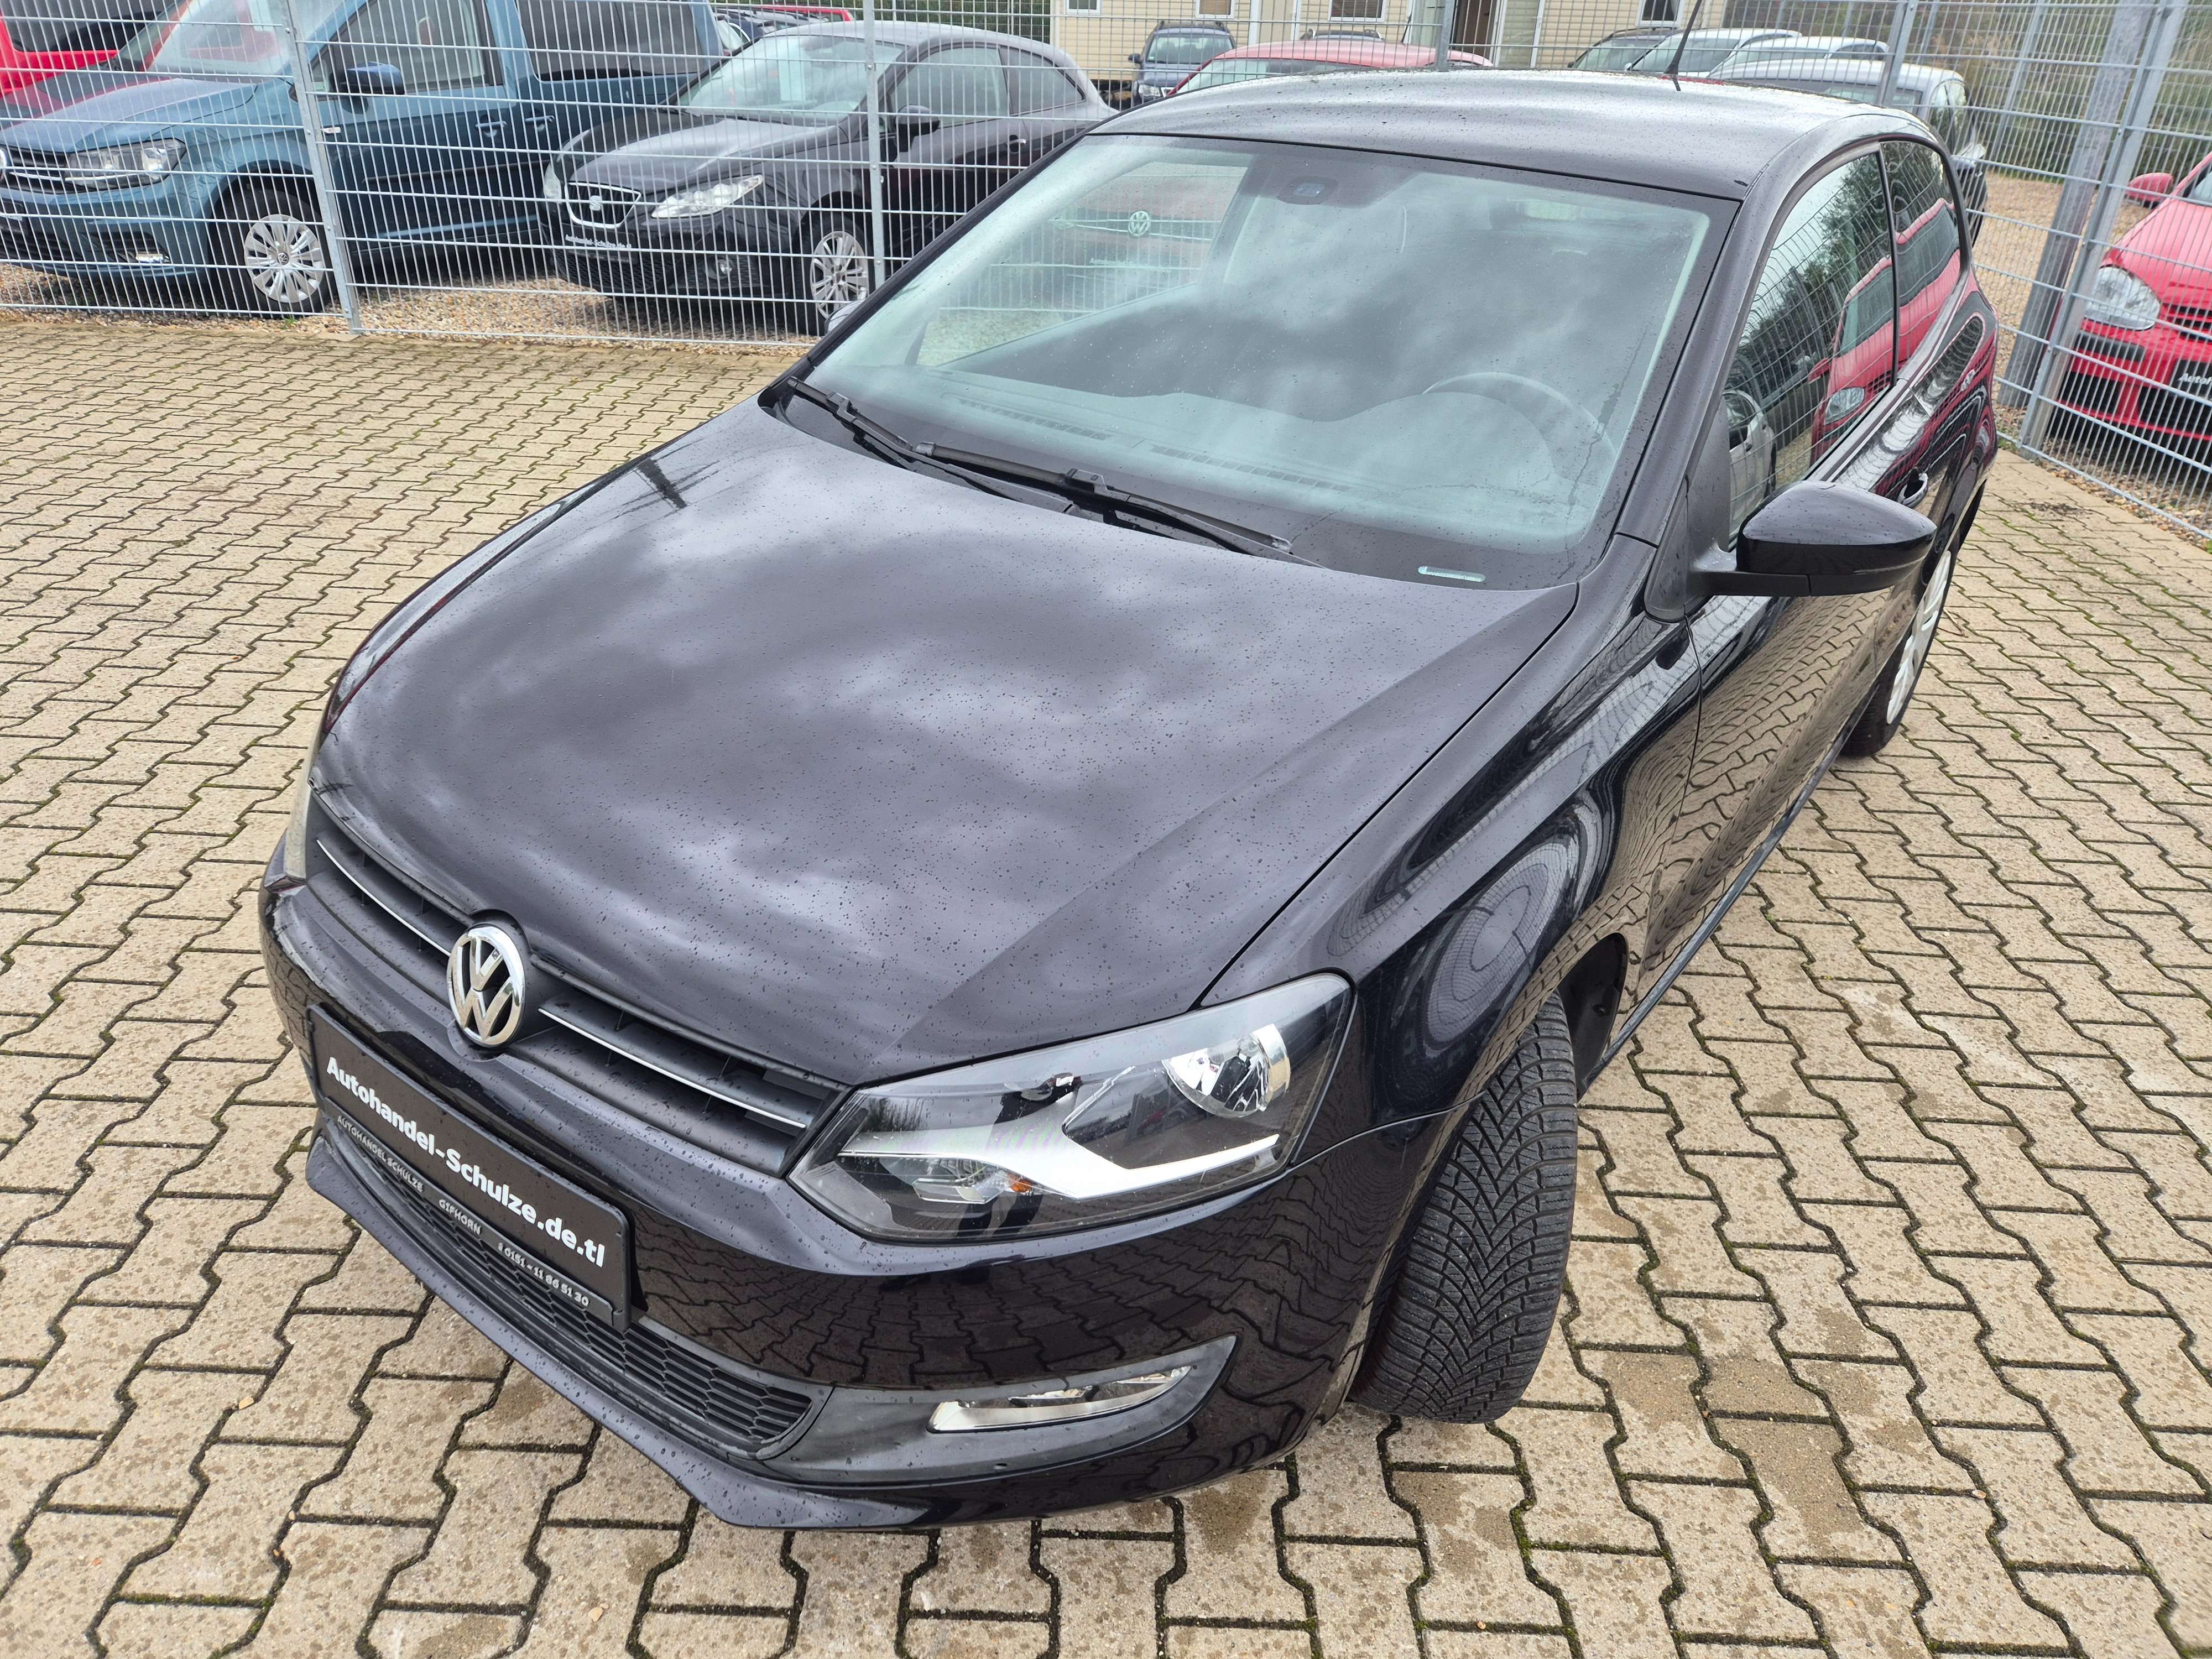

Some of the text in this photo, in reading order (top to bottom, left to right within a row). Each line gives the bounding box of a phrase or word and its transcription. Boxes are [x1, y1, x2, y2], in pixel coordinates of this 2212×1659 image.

[446, 926, 525, 1046] VW
[326, 1057, 606, 1267] Autohandel-Schulze.de.tl
[337, 1115, 387, 1162] AUTOHANDEL
[387, 1157, 424, 1193] SCHULZE
[439, 1198, 482, 1235] GIFHORN
